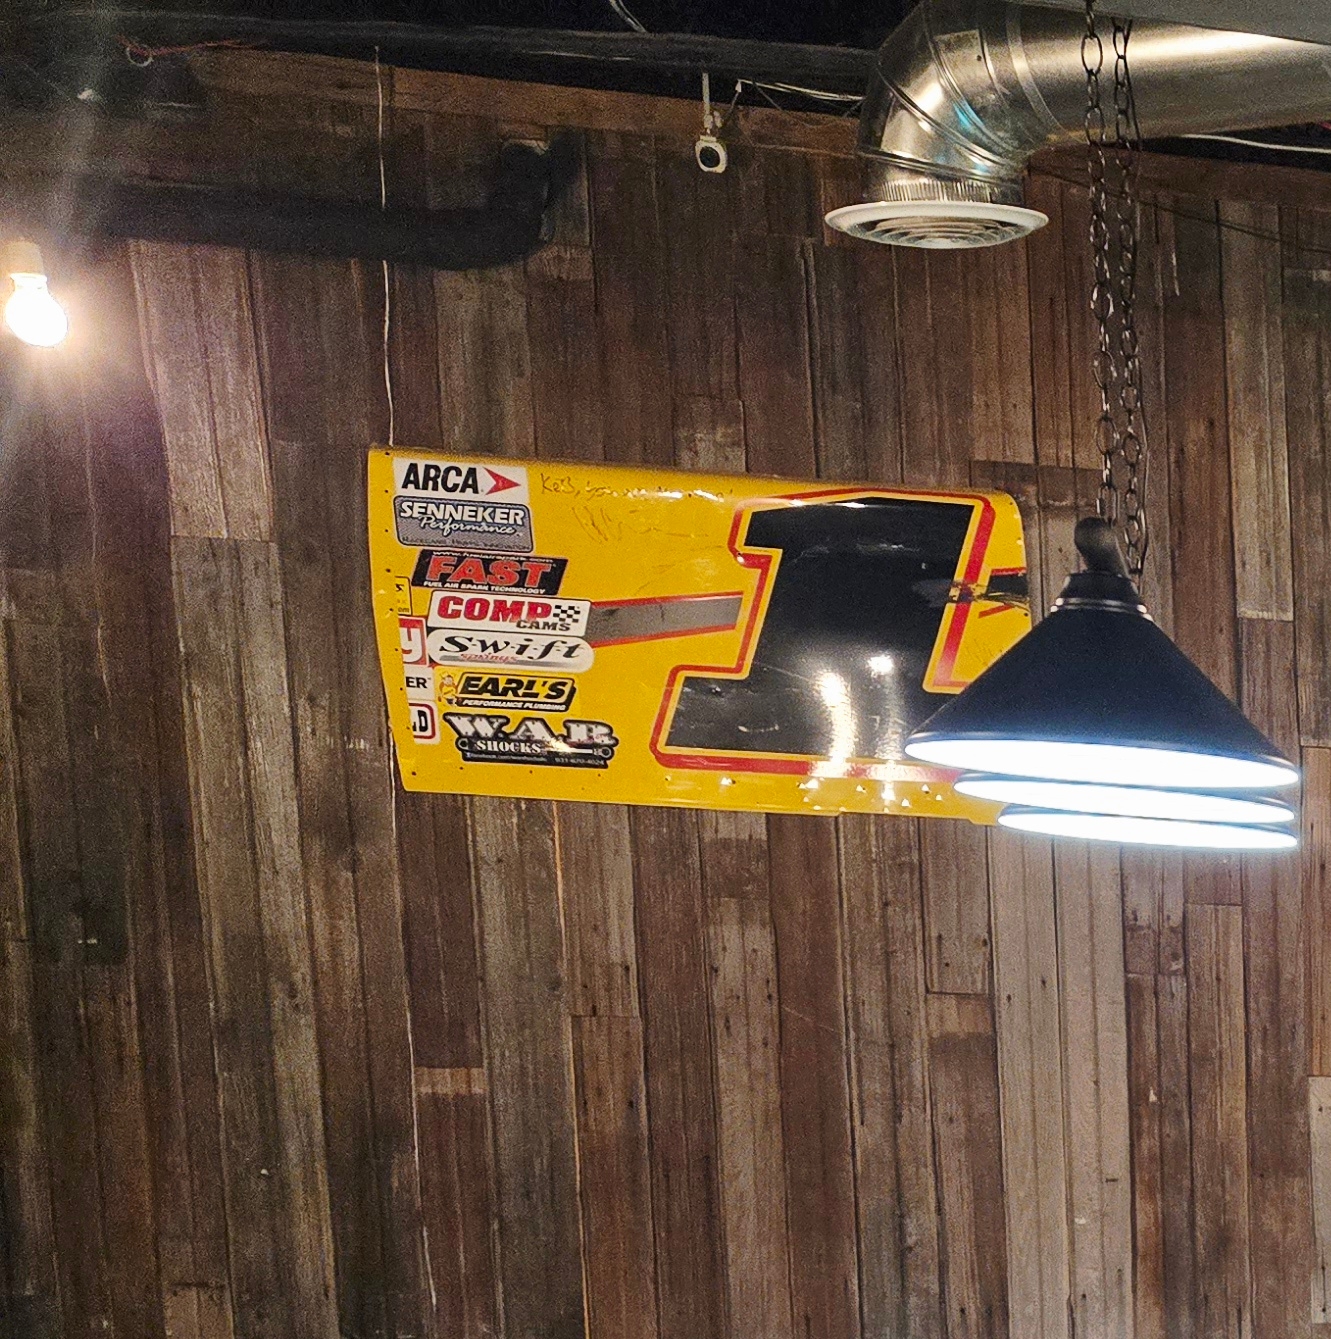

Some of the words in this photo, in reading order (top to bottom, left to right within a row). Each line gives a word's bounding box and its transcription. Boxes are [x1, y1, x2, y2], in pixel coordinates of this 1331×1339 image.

[401, 462, 480, 494] ARCA
[400, 501, 525, 526] SENNEKER
[419, 514, 516, 537] Performance
[425, 554, 552, 588] FAST
[423, 580, 443, 588] FUEL
[460, 583, 489, 591] SPARK
[490, 586, 546, 594] TECHNOLOGY
[437, 595, 553, 623] COMP
[515, 619, 572, 632] CAMS
[459, 676, 569, 700] EARL'S
[462, 699, 524, 709] PERFORMANCE
[523, 702, 567, 711] PLUMBING
[474, 740, 542, 754] SHOCKS
